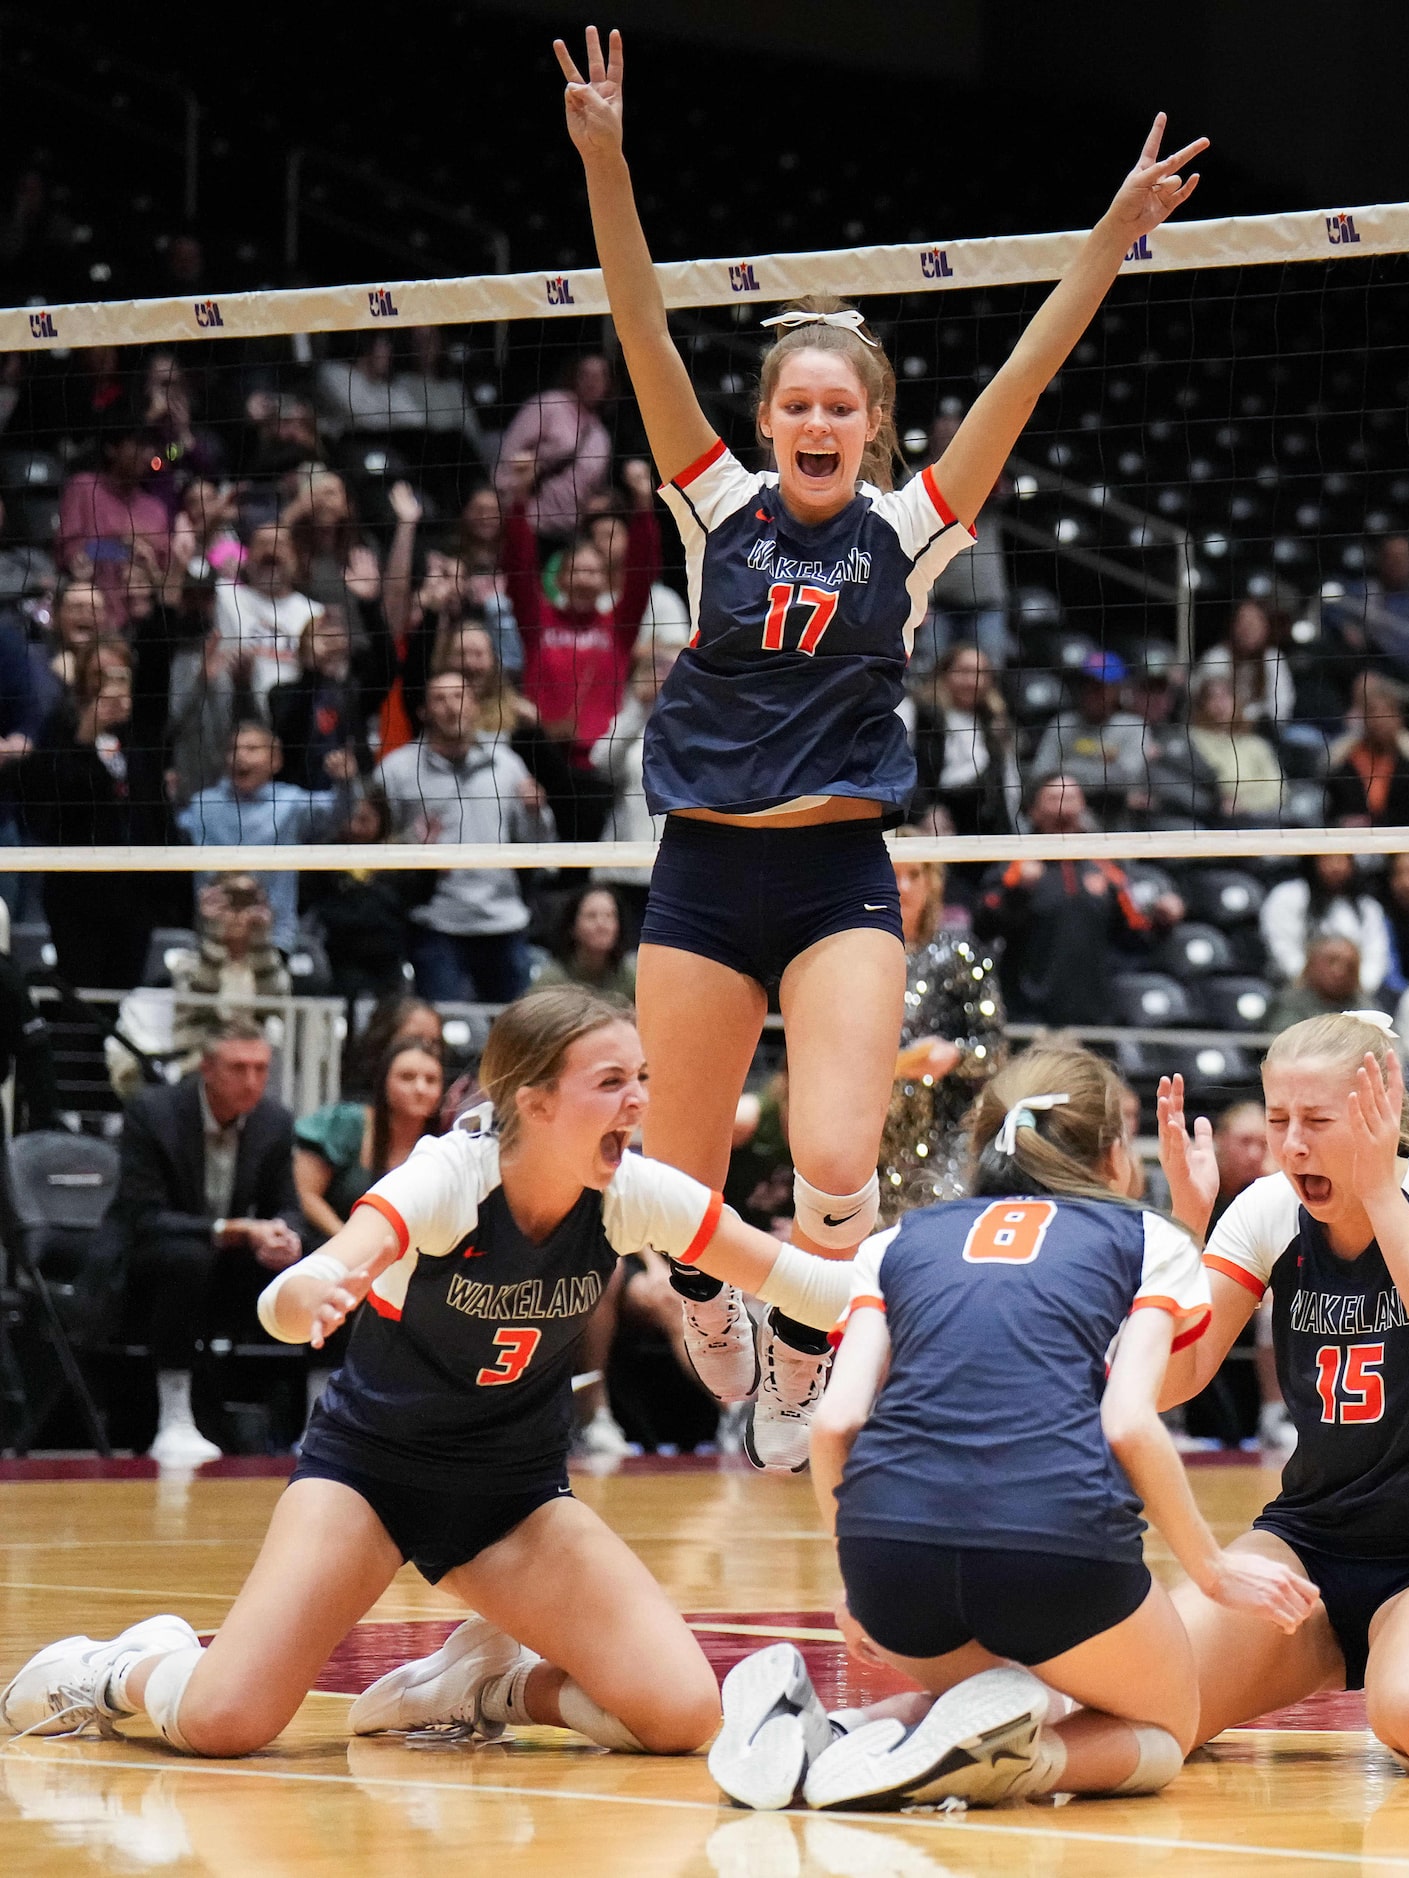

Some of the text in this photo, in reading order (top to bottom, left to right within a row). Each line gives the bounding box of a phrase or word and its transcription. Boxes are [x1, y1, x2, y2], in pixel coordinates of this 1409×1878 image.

[747, 538, 872, 586] WAKELAND
[761, 582, 840, 657] 17
[962, 1200, 1058, 1265] 8
[475, 1327, 542, 1387] 3
[1315, 1342, 1385, 1425] 15
